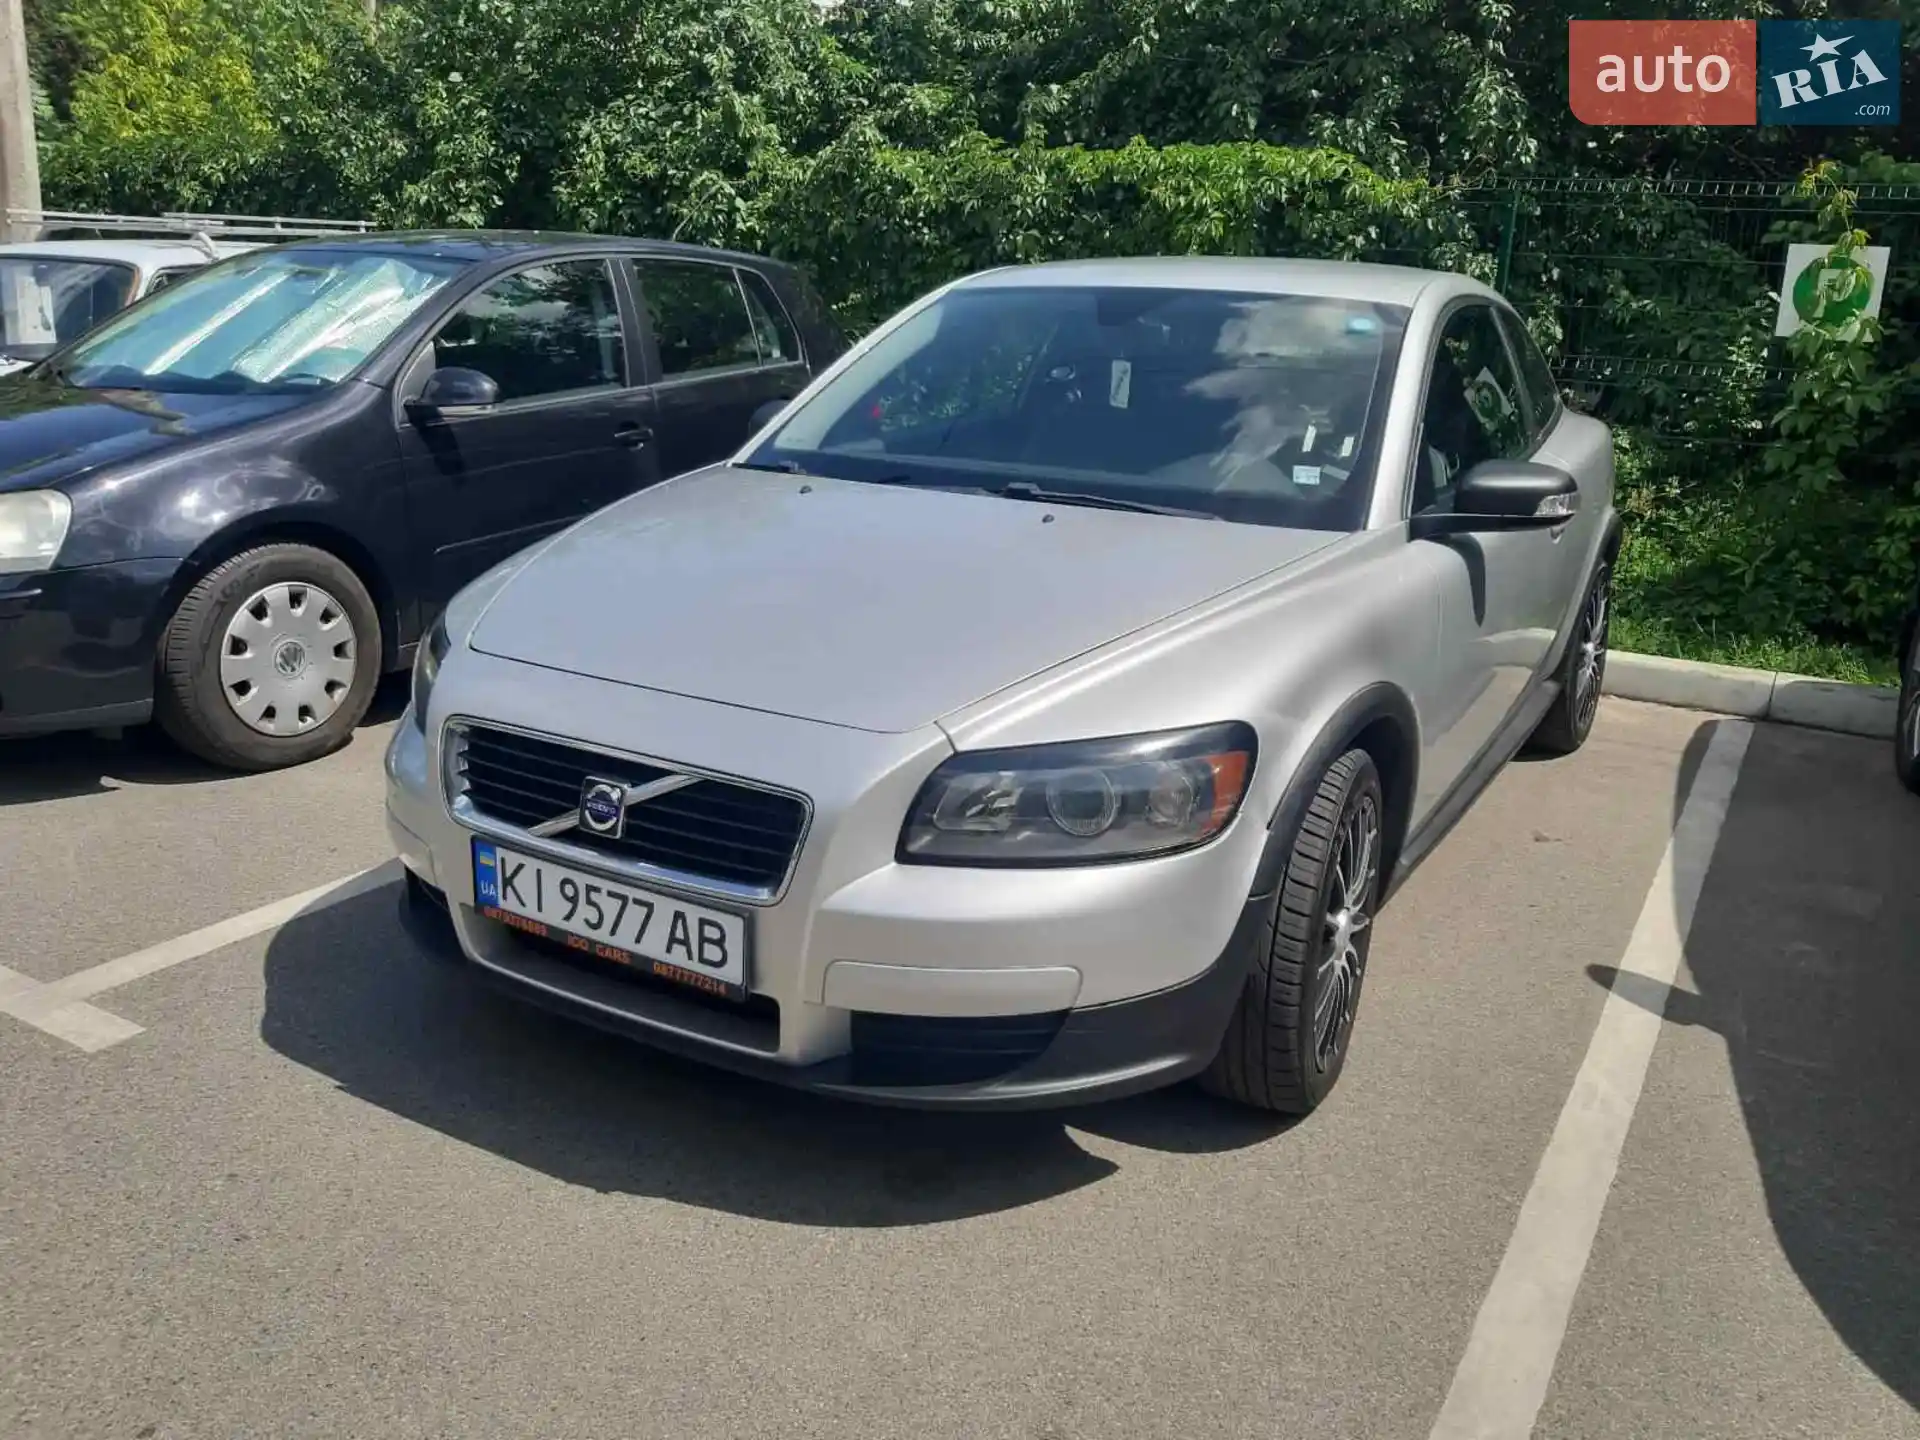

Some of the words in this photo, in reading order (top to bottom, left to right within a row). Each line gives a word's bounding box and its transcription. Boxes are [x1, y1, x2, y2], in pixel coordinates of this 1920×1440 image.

[481, 879, 497, 899] UA
[500, 856, 543, 913] KI
[558, 877, 655, 945] 9577
[665, 910, 729, 969] AB
